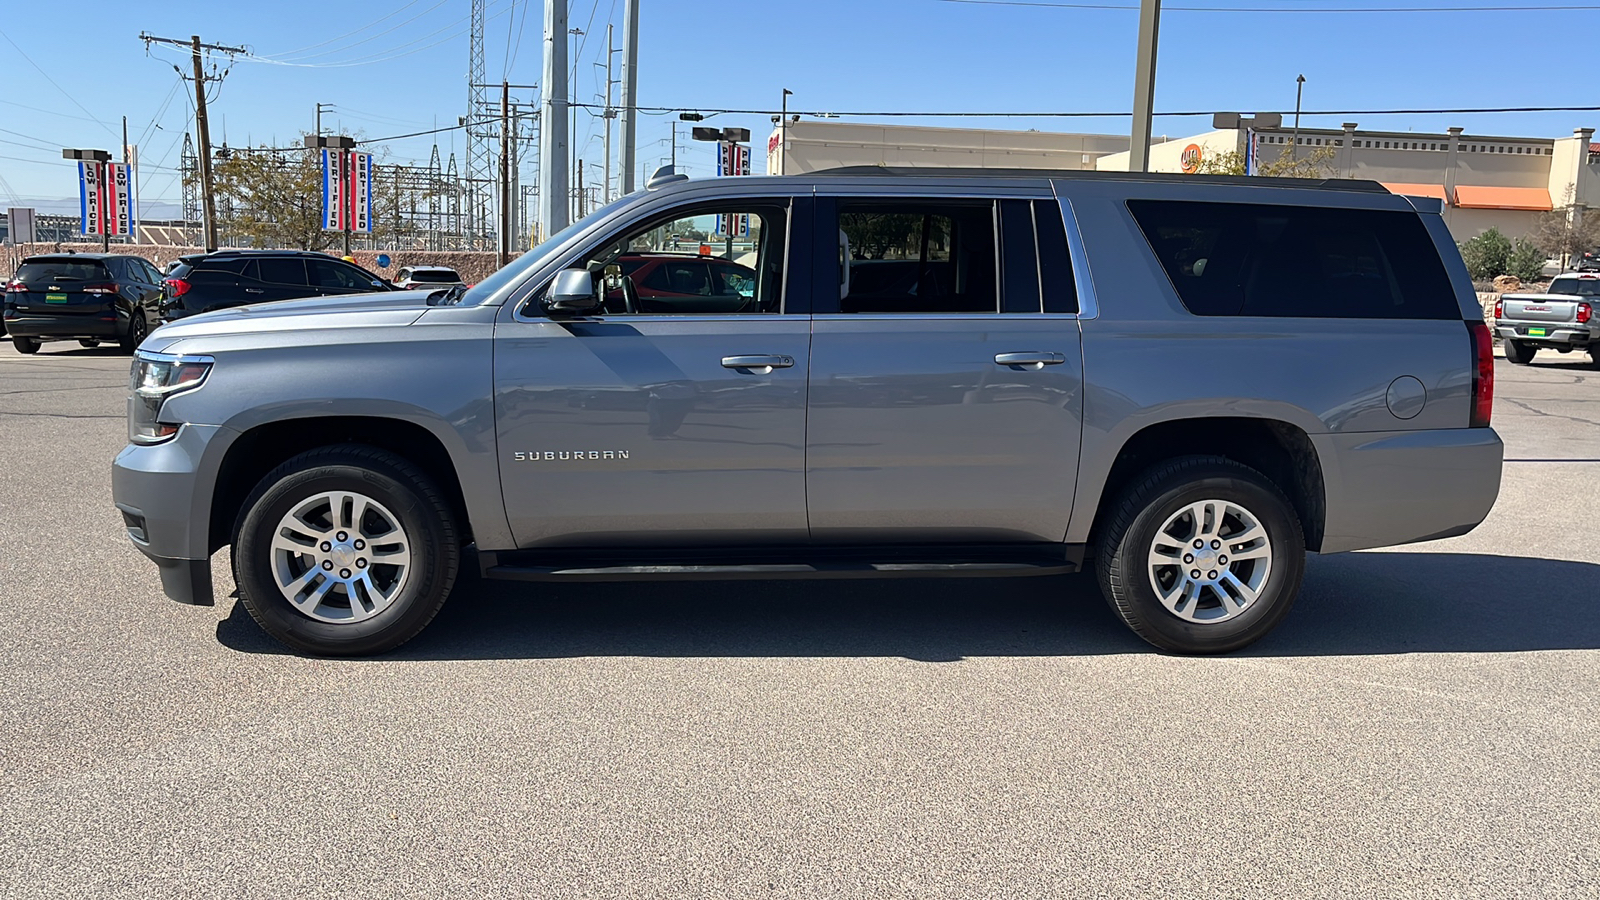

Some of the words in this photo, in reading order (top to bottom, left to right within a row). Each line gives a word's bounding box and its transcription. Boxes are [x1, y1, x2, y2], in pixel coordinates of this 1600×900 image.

[86, 164, 96, 185] LOW
[117, 166, 126, 186] LOW
[330, 151, 339, 227] CERTIFIED
[358, 155, 366, 229] CERTIFIED
[88, 191, 97, 233] PRICES
[119, 192, 128, 234] PRICES
[514, 450, 630, 461] SUBURBAN
